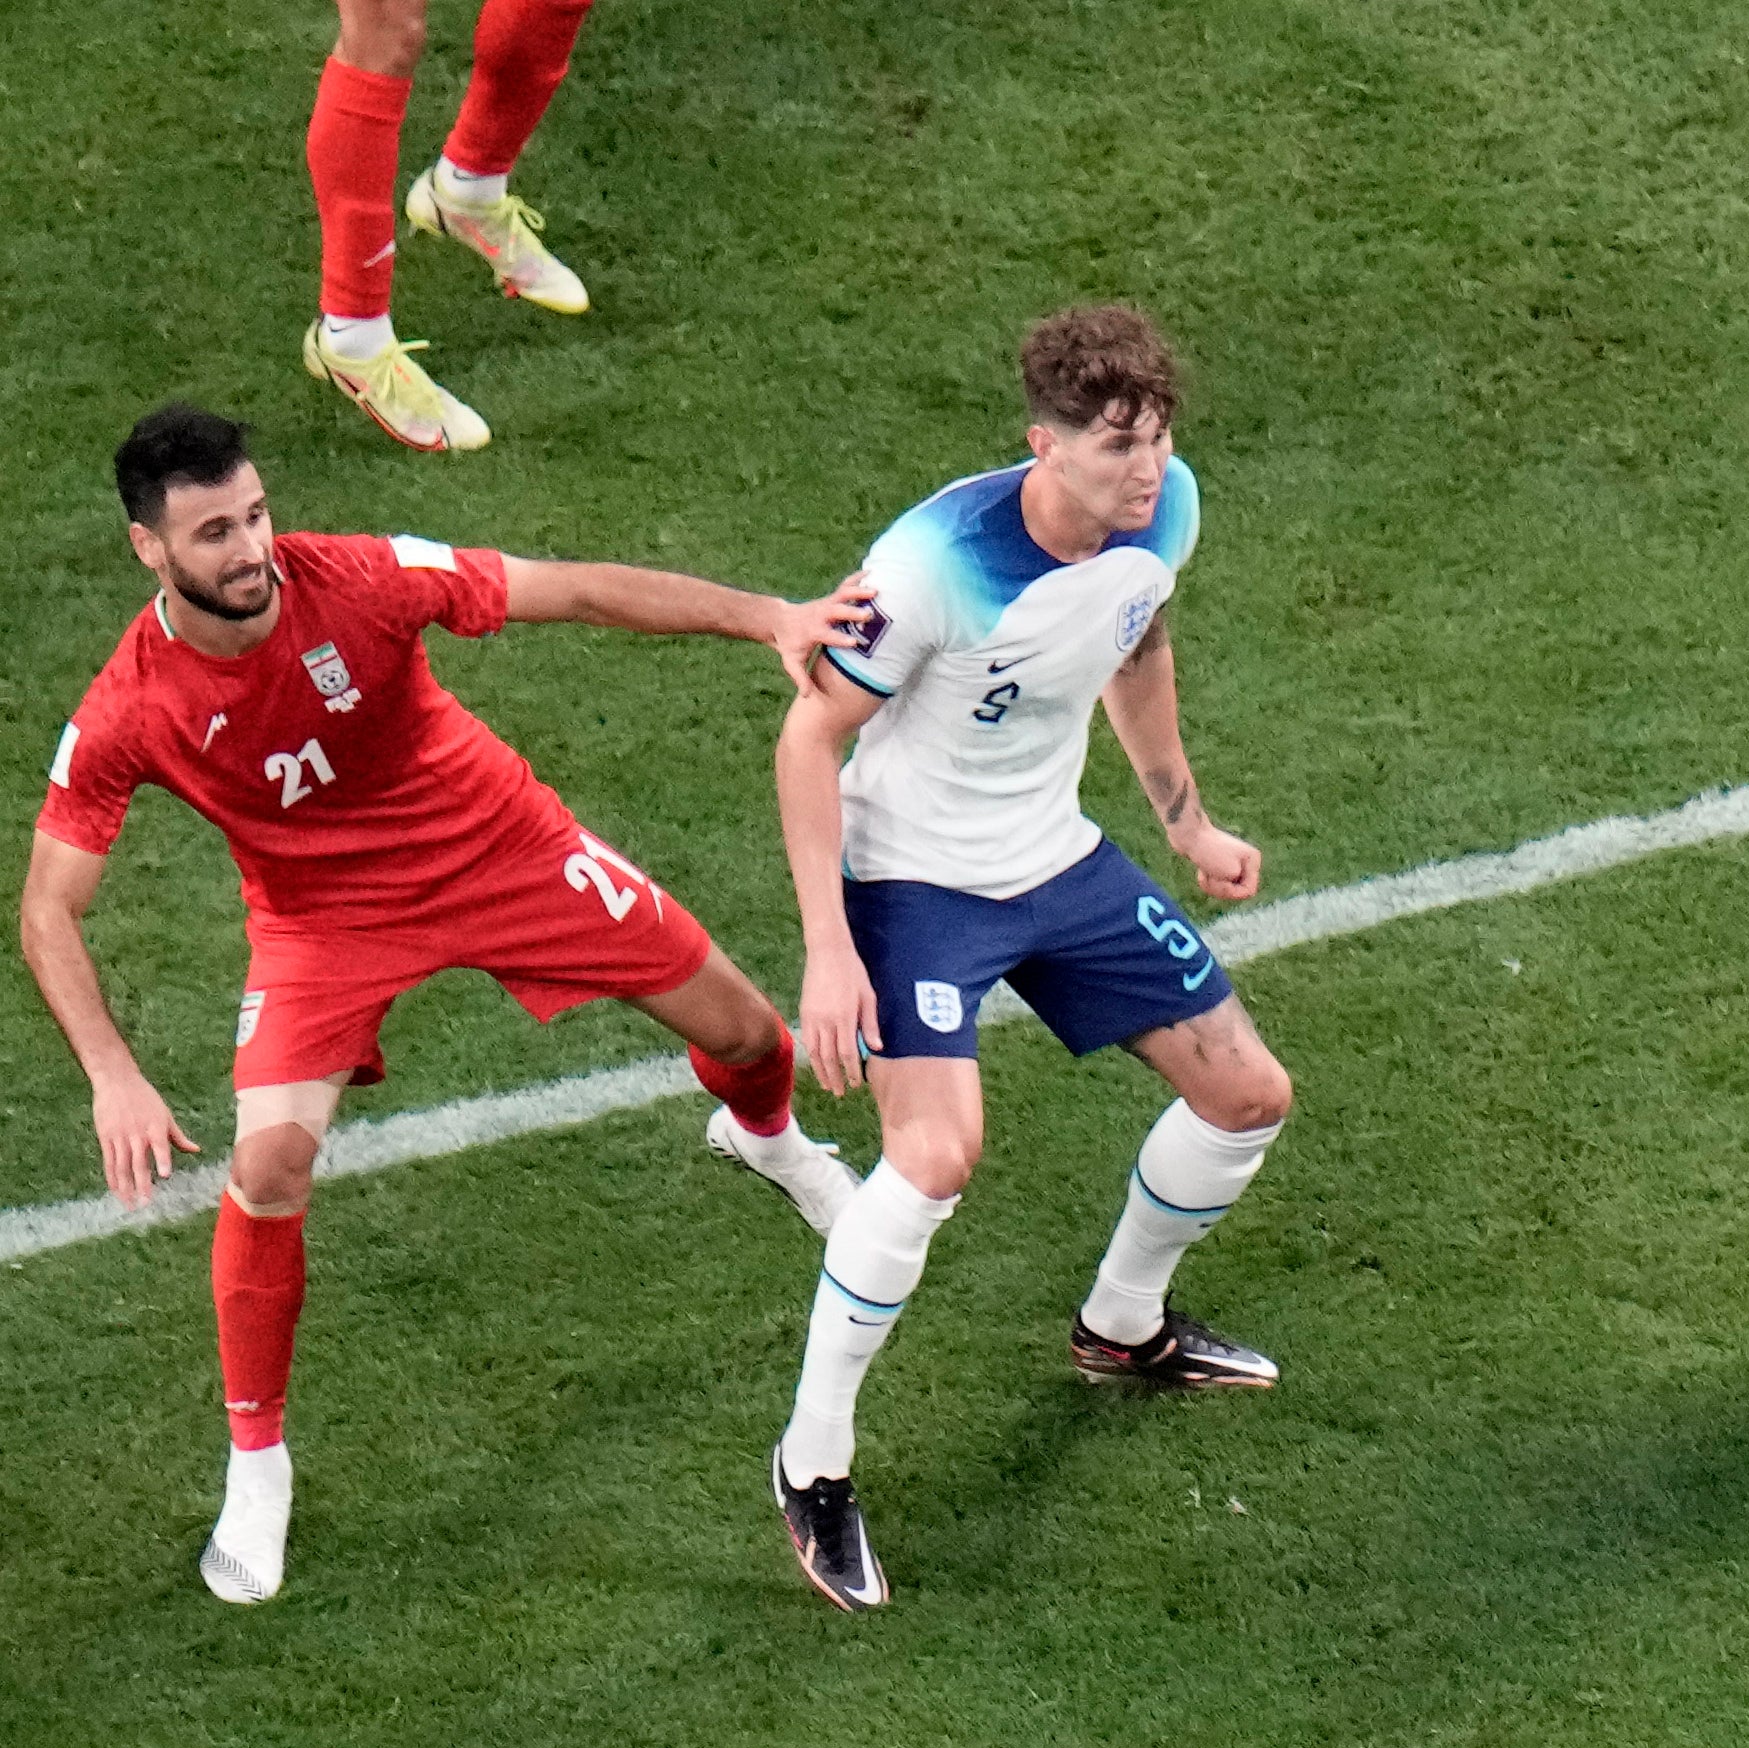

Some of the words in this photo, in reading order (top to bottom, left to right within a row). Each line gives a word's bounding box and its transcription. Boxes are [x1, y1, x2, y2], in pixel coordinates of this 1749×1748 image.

[972, 680, 1021, 723] 5
[264, 738, 337, 808] 21
[563, 832, 646, 922] 21
[1137, 894, 1199, 958] 5
